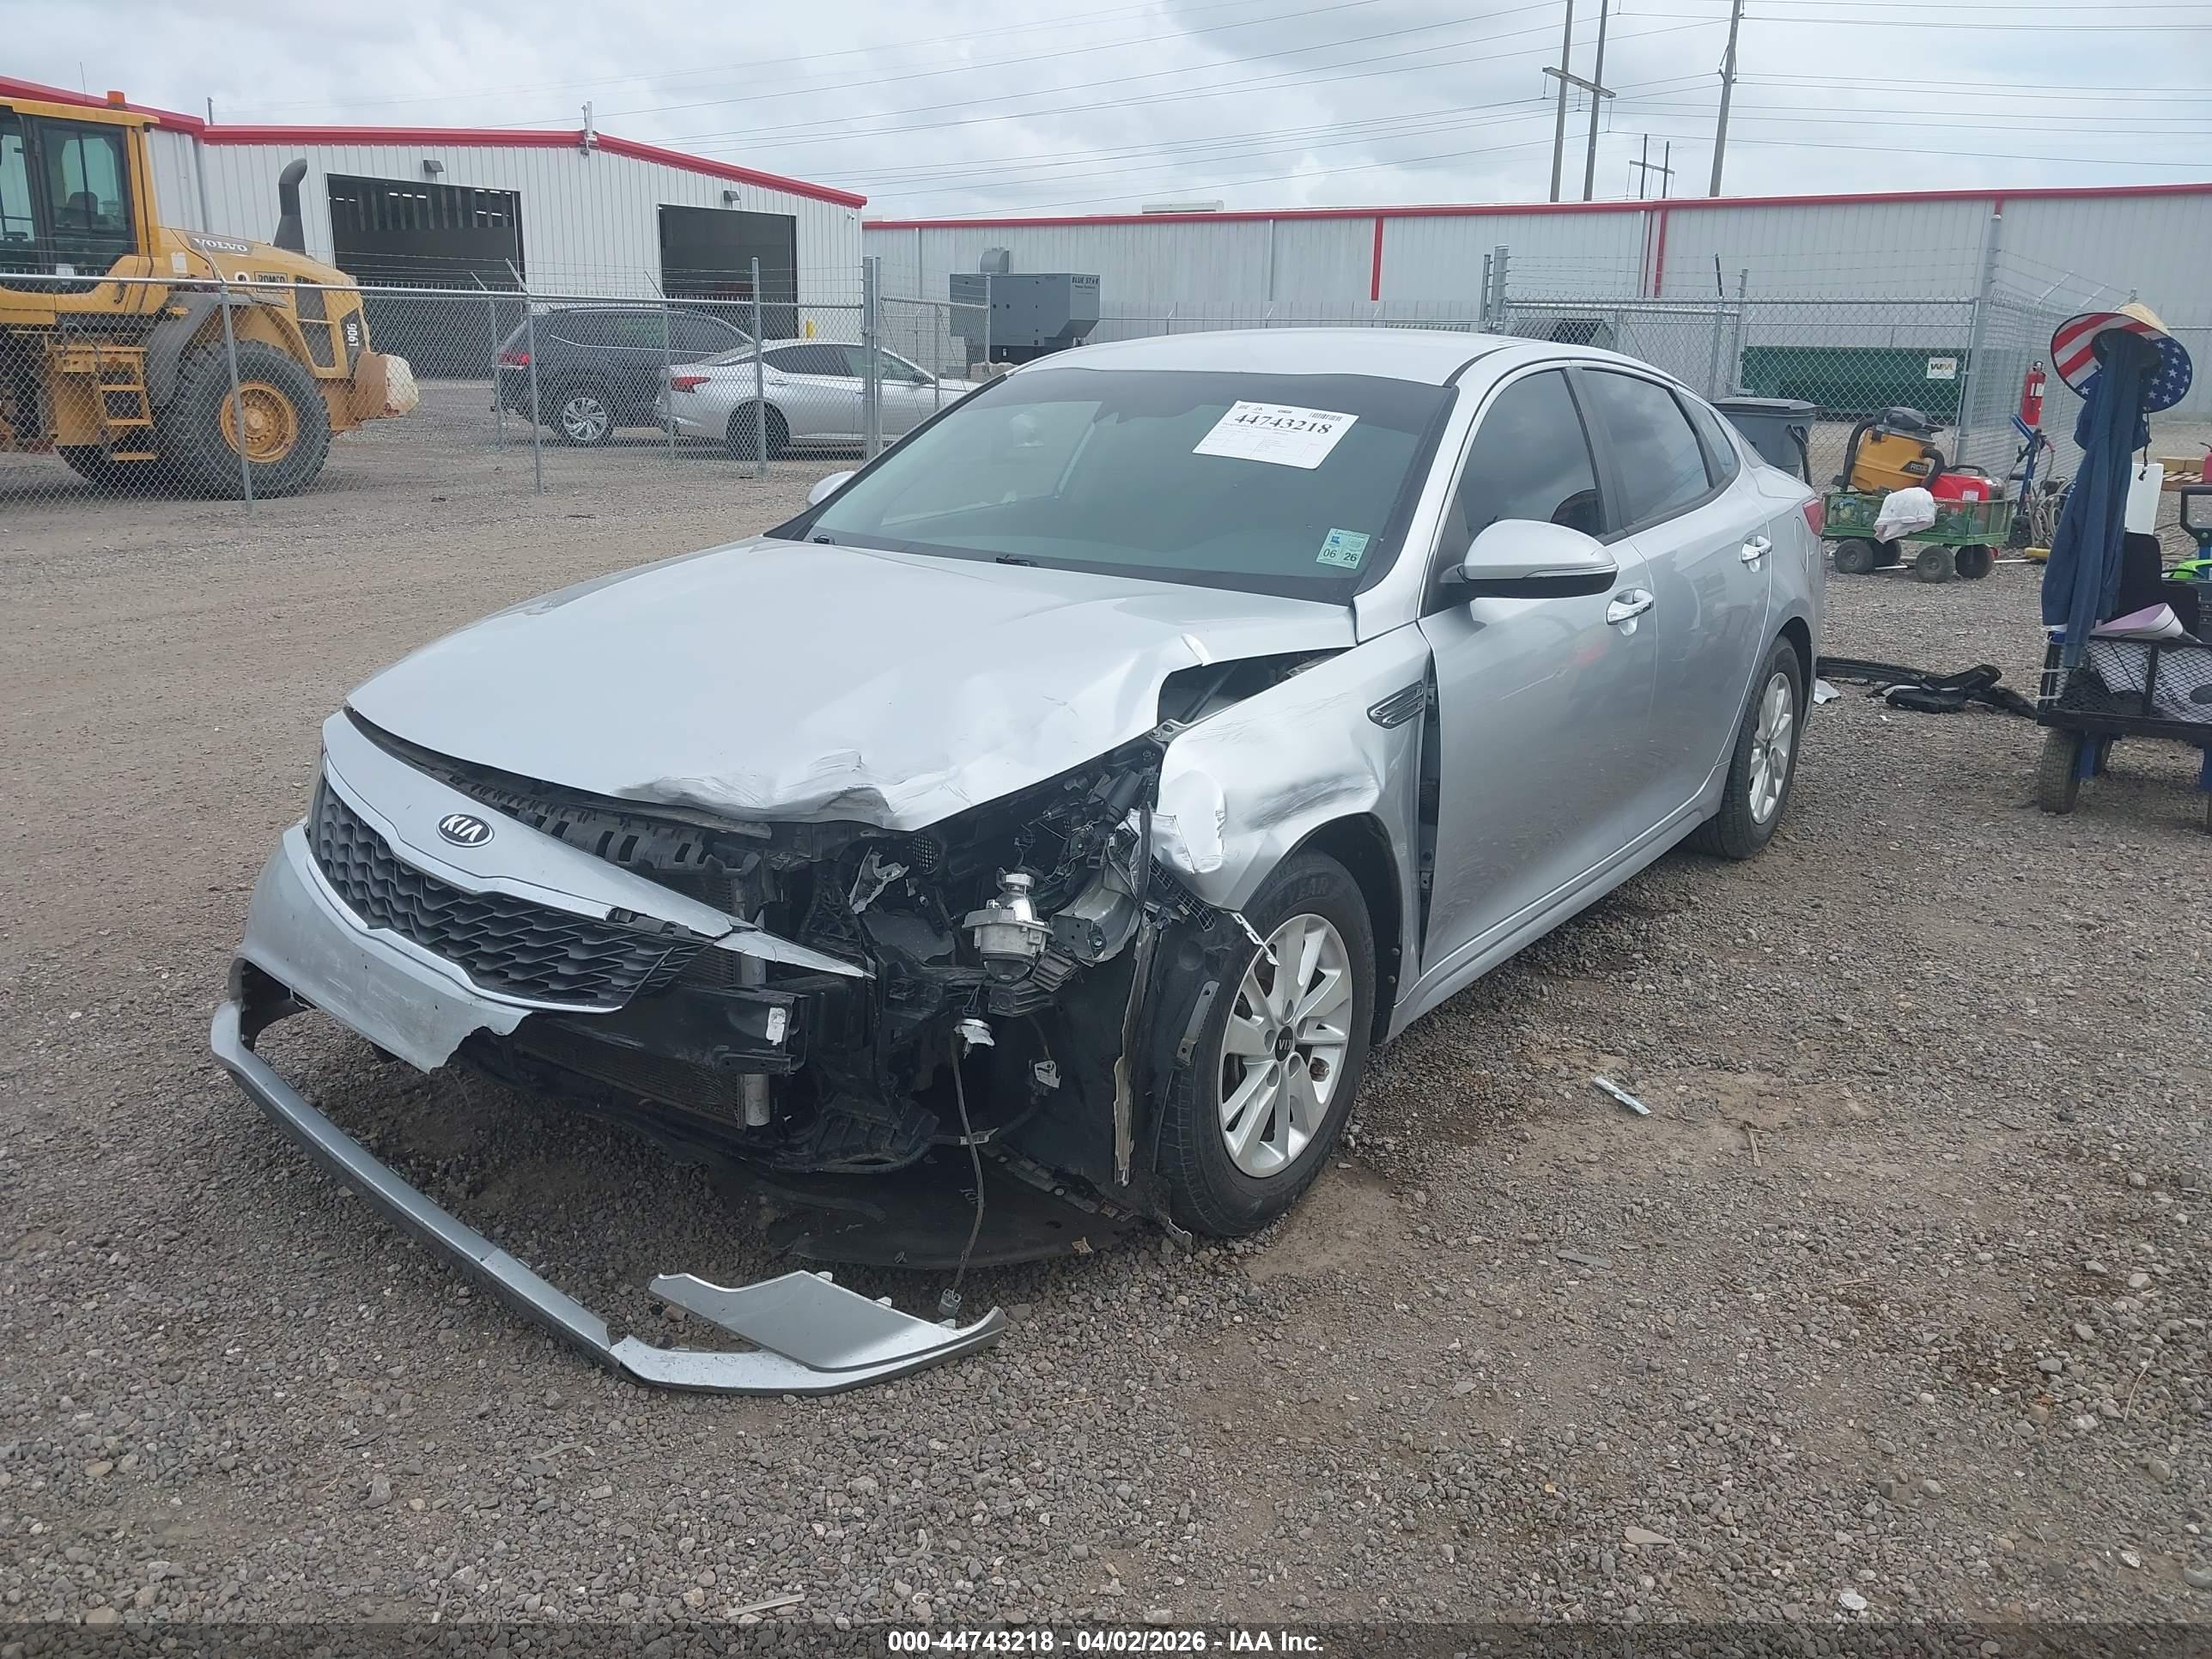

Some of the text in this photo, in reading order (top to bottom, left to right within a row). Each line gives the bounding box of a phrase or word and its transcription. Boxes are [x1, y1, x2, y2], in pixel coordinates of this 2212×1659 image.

[191, 237, 248, 252] VOLVO
[346, 323, 359, 347] L90G
[1234, 414, 1333, 434] 44743218
[1323, 549, 1358, 562] 06 26
[441, 815, 483, 842] KIA
